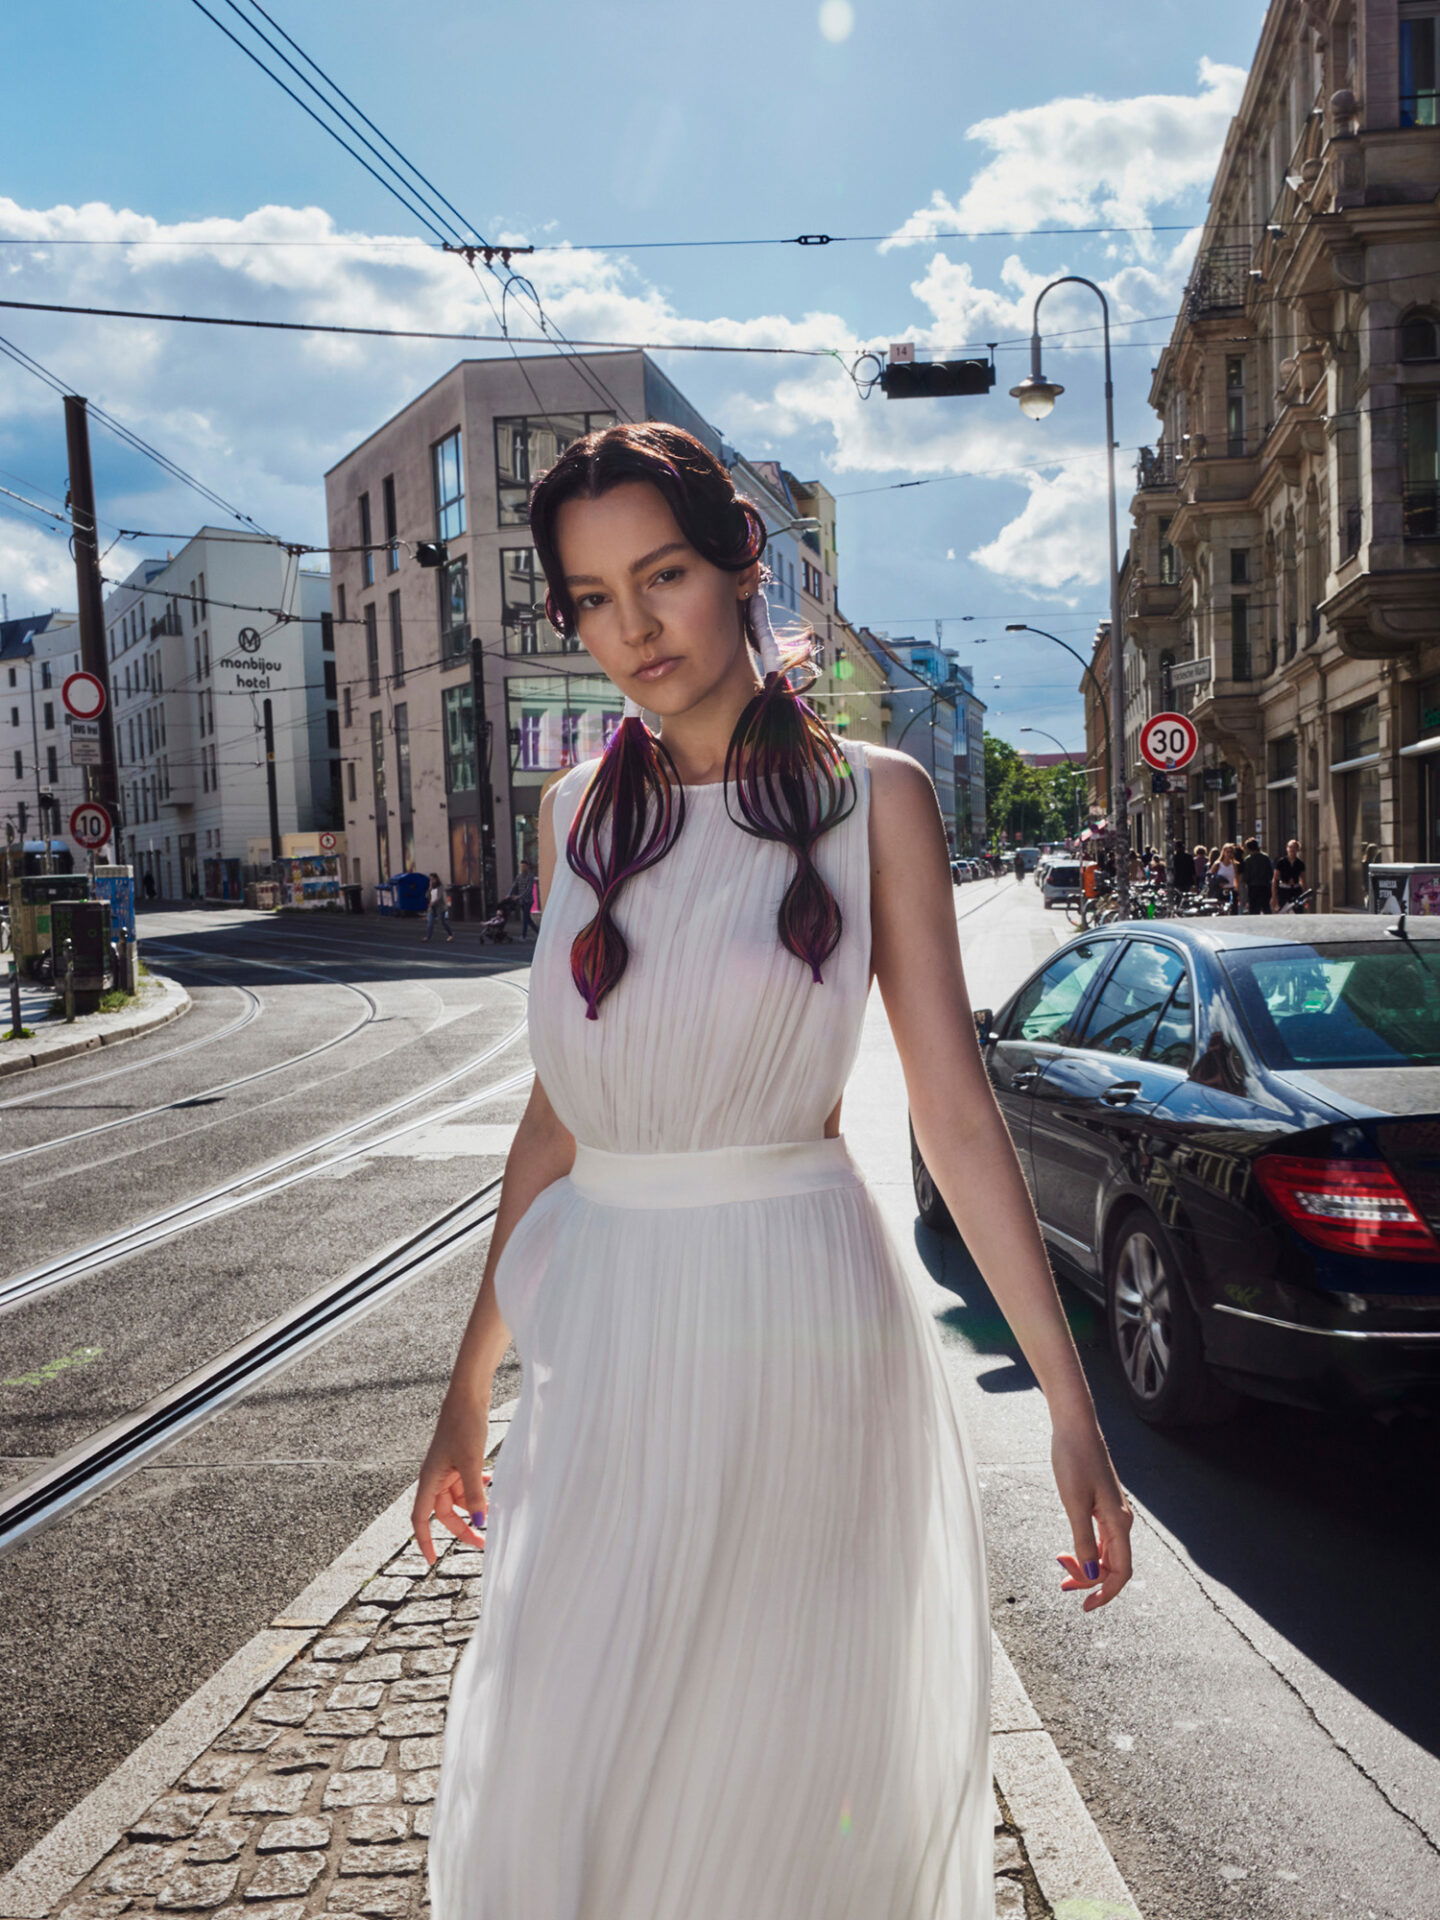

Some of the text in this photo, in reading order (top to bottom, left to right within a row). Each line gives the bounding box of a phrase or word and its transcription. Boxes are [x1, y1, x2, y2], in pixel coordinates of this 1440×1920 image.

[220, 657, 282, 675] monbijou
[236, 674, 270, 689] hotel
[1152, 728, 1185, 754] 30
[80, 815, 101, 837] 10
